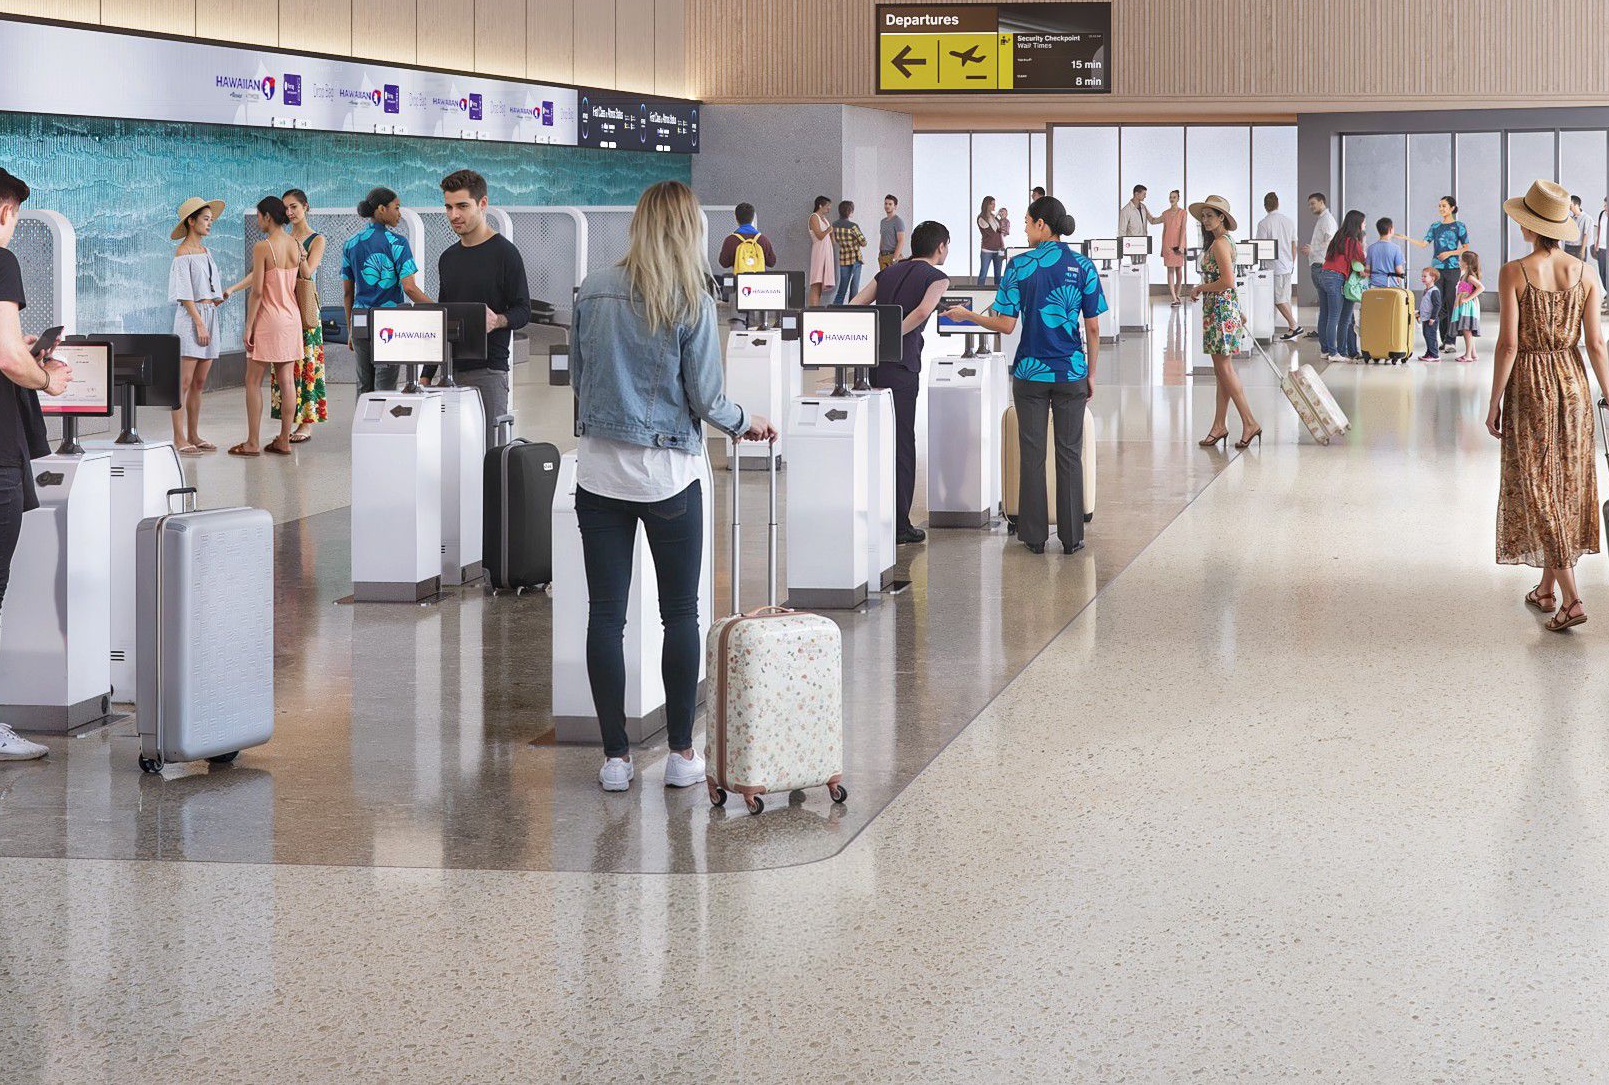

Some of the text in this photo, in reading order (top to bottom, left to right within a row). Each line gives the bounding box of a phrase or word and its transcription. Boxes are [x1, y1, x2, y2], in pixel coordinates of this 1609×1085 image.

[885, 13, 959, 28] Departures
[1017, 35, 1081, 43] Security Checkpoint
[1071, 60, 1102, 69] 15 min
[216, 75, 261, 92] HAWAIIAN
[1075, 77, 1102, 86] 8 min
[339, 89, 372, 101] HAWAIIAN
